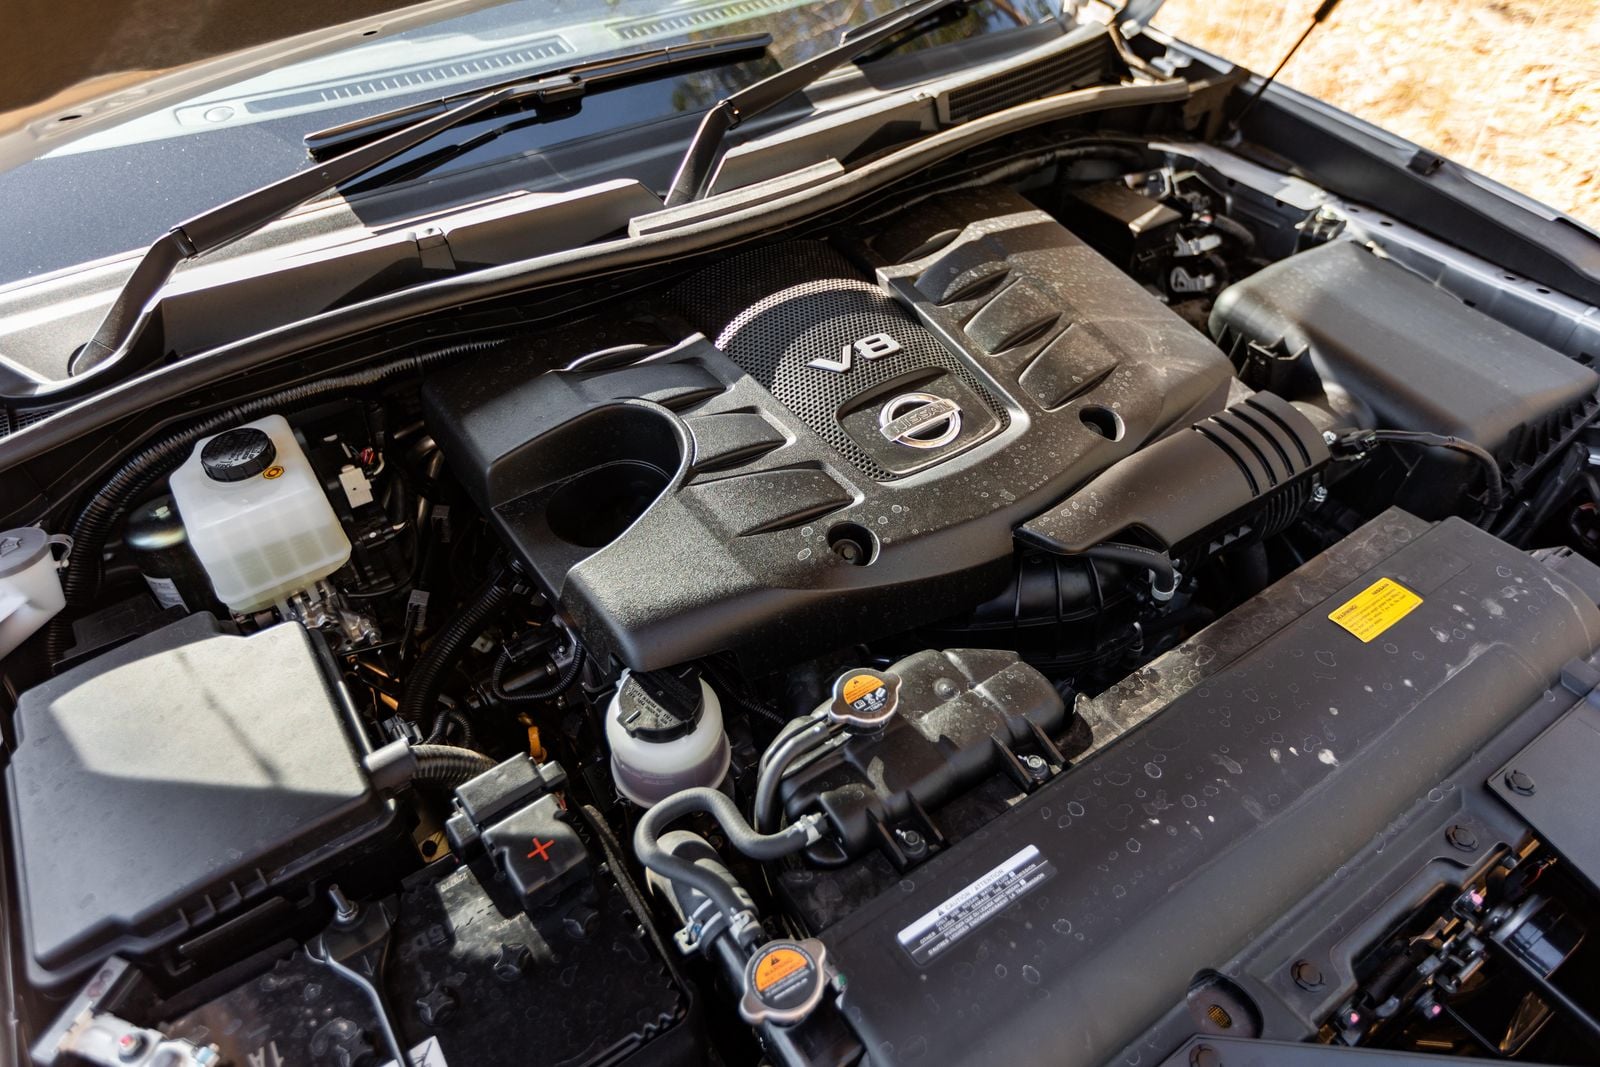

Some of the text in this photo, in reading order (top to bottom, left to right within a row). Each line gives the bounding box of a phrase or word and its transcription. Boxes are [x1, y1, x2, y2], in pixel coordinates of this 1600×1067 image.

[806, 332, 900, 374] V8
[892, 401, 953, 433] NISSAN
[919, 931, 936, 944] OTHER
[938, 918, 955, 931] FLUIDS
[1004, 863, 1036, 886] TRANSMISSION
[945, 891, 971, 910] CAUTION
[974, 868, 1004, 891] ATTENTION
